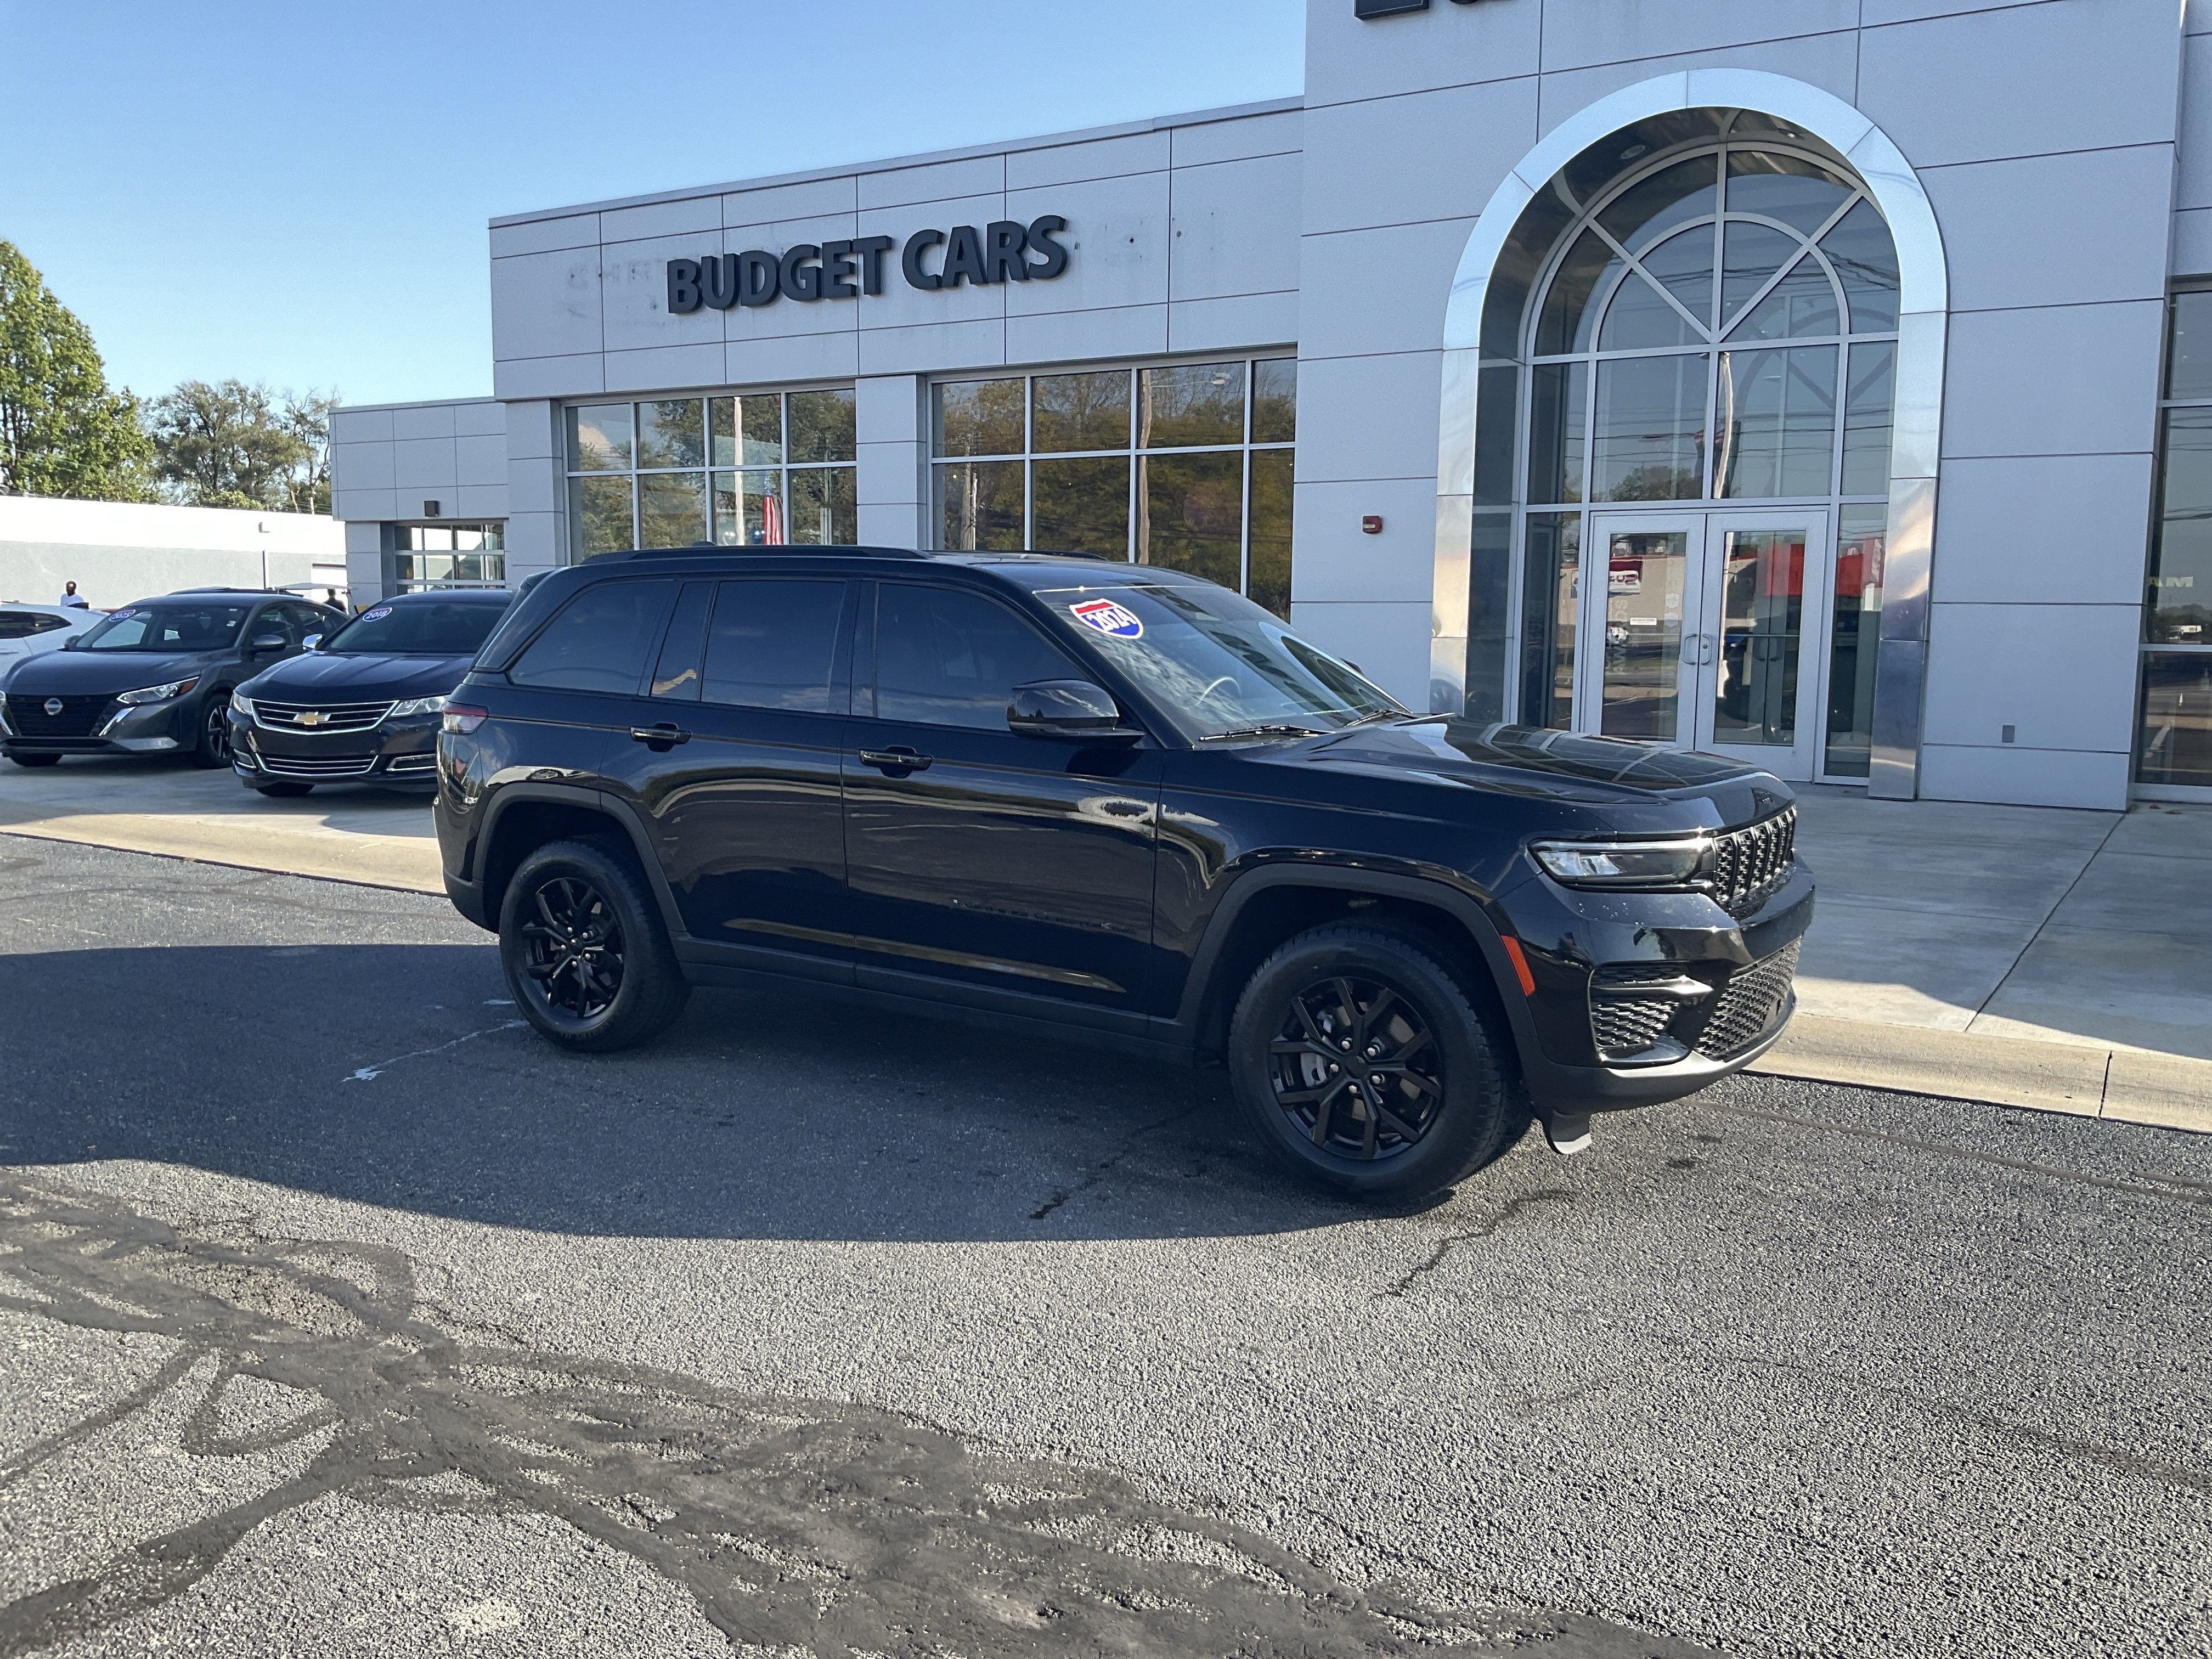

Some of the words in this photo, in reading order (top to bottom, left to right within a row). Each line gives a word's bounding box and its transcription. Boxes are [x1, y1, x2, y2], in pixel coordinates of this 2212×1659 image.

[667, 235, 892, 314] BUDGET
[902, 215, 1068, 290] CARS
[1086, 607, 1137, 631] 2024
